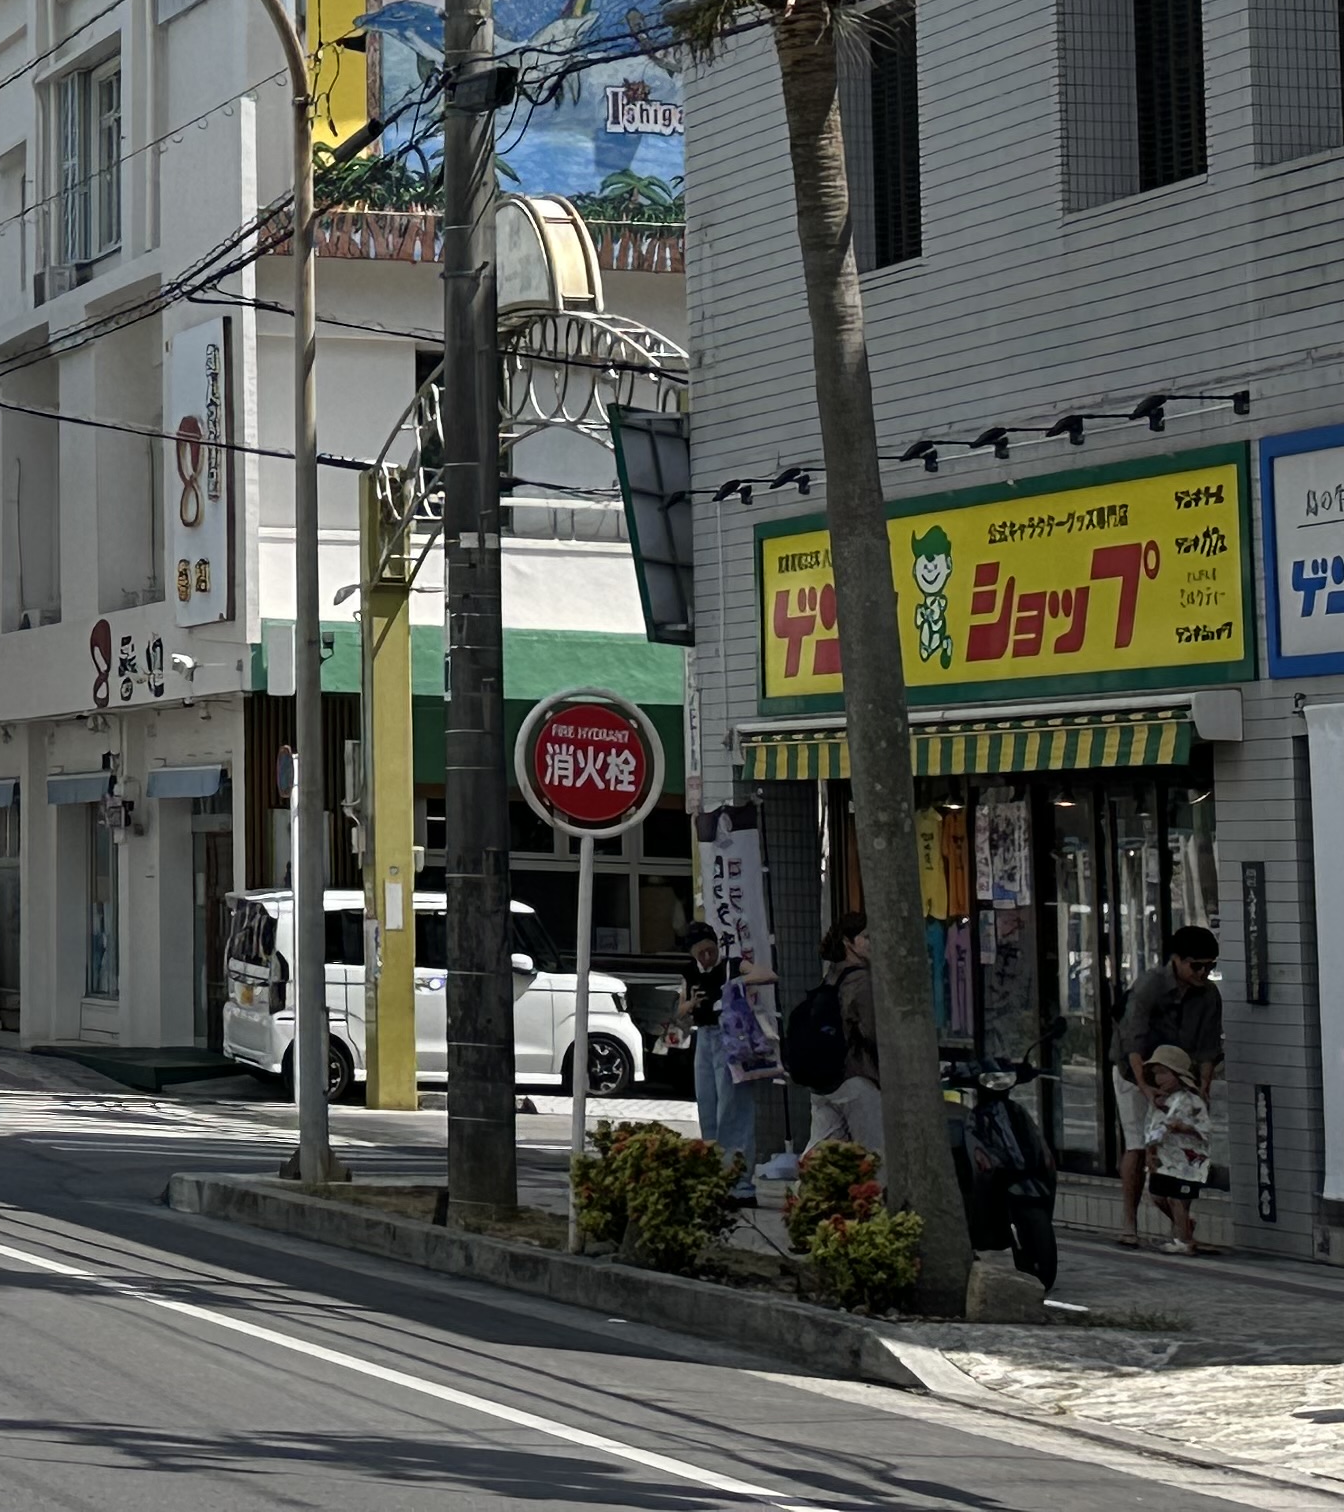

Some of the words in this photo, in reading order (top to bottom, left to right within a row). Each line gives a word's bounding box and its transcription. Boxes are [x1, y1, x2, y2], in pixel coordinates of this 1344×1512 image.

[966, 539, 1161, 662] ショップ
[551, 723, 575, 738] FIRE
[577, 726, 630, 743] HYDRANT
[544, 742, 637, 793] 消火栓
